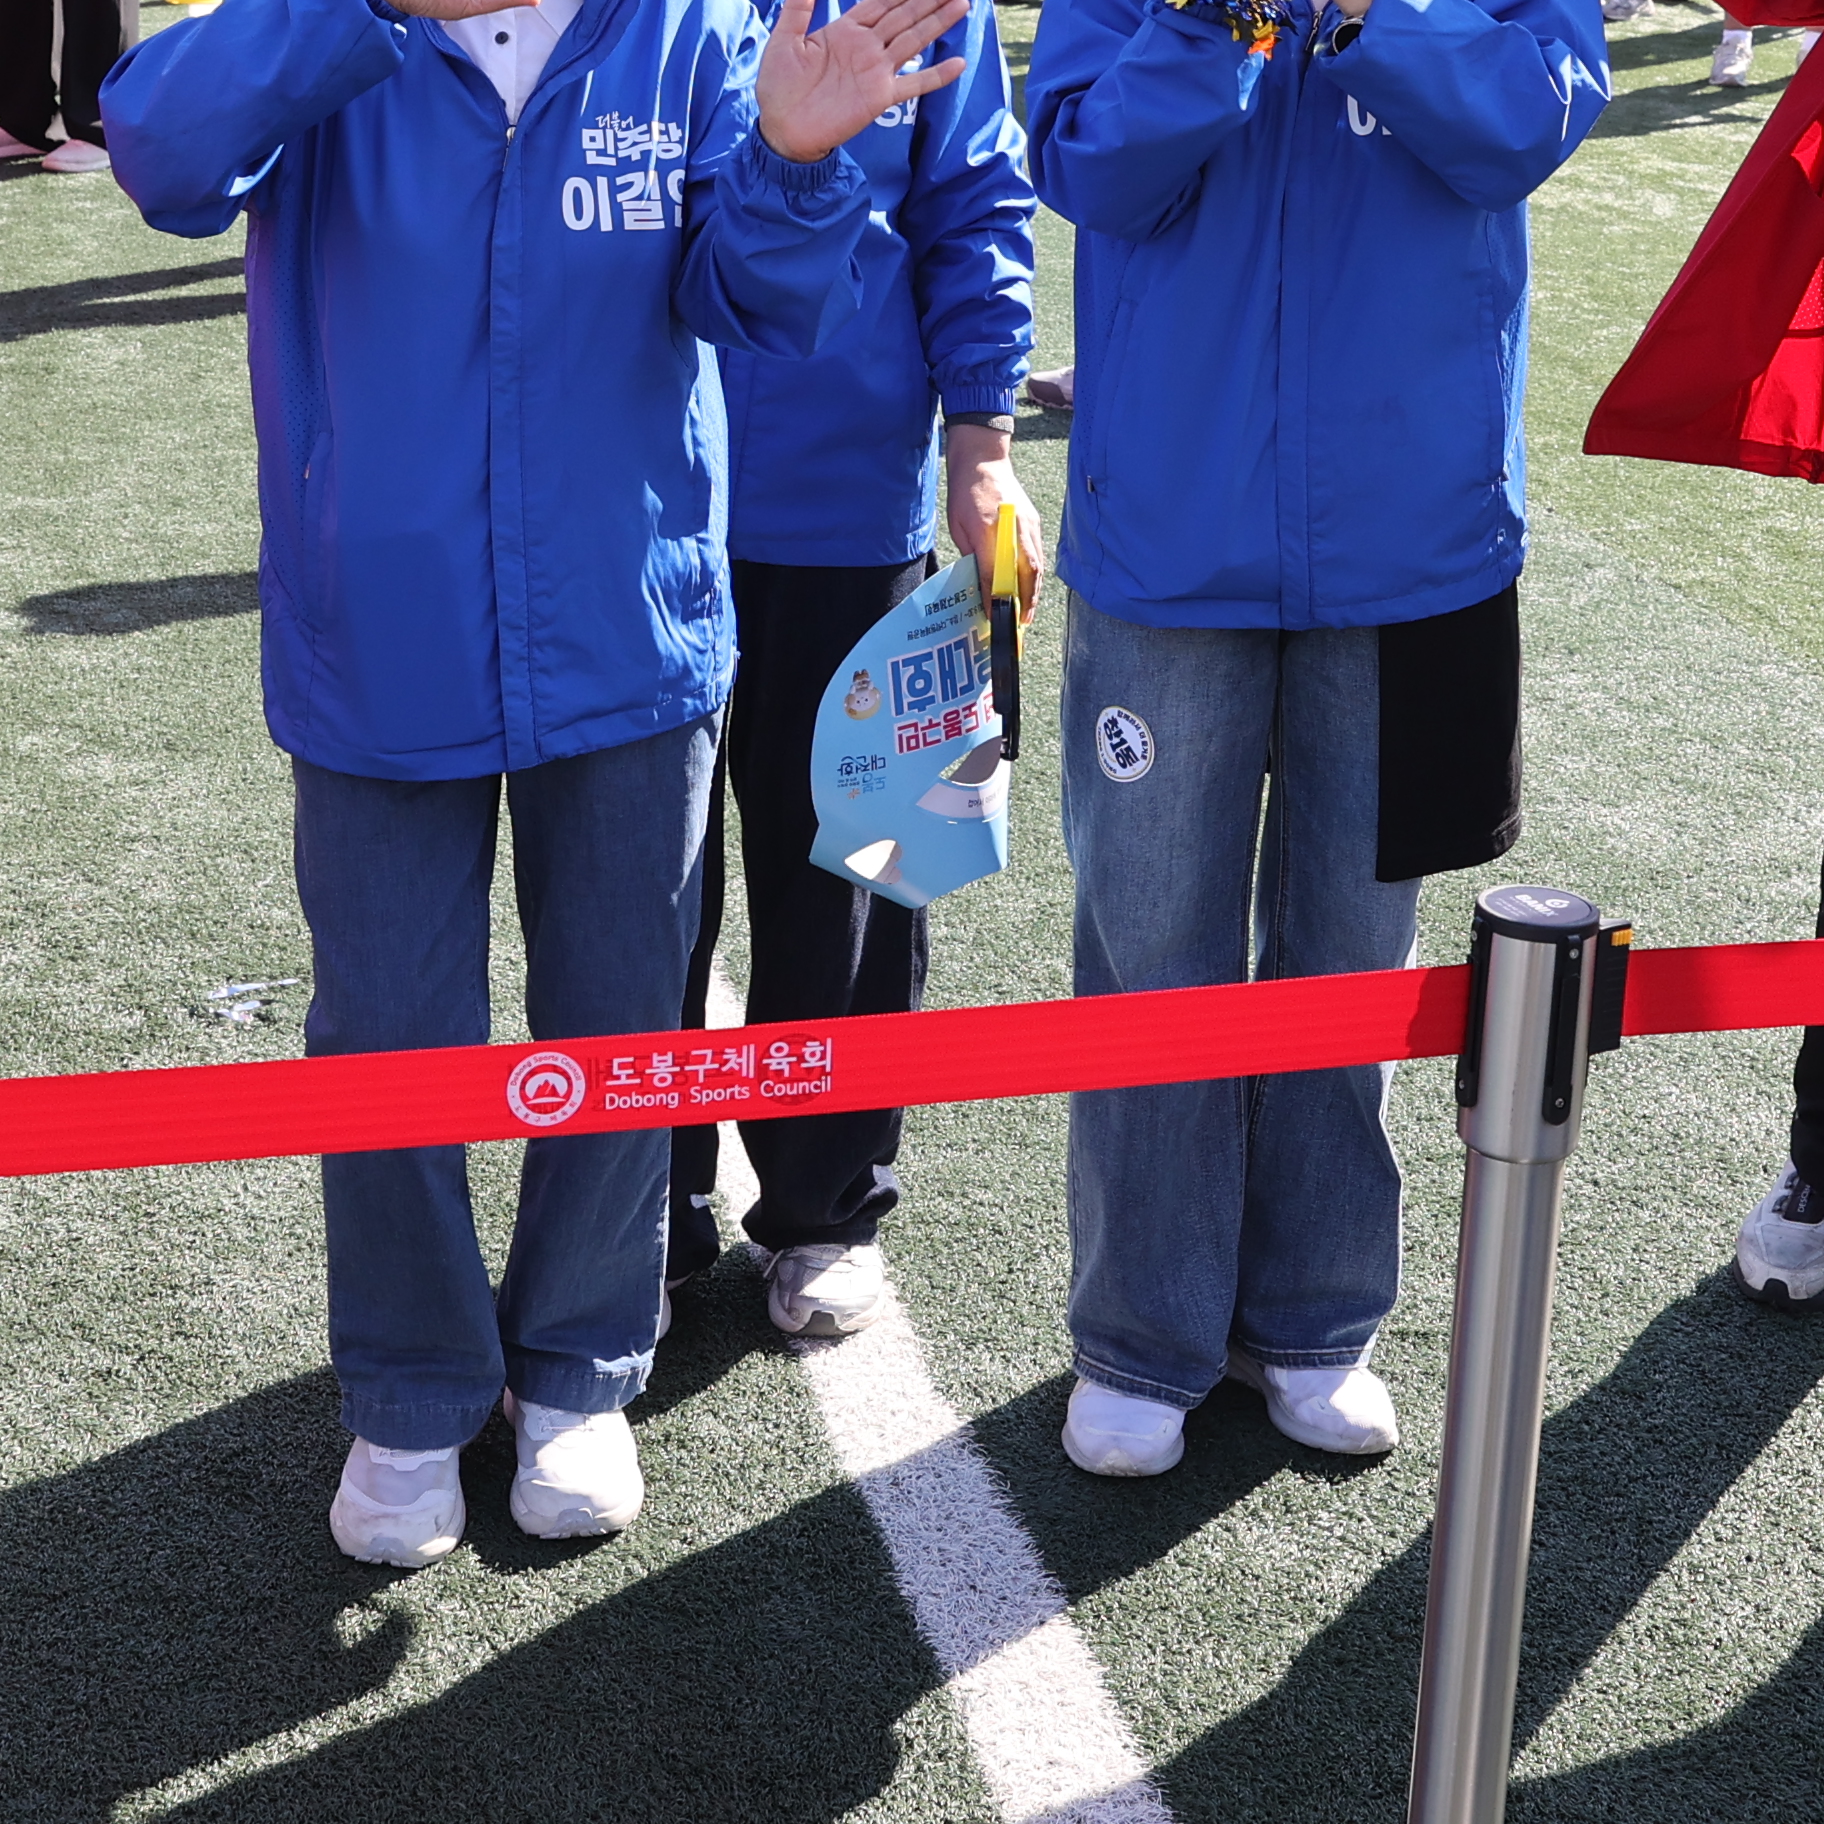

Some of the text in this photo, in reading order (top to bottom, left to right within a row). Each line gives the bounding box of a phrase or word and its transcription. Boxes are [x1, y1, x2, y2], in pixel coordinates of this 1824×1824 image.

[582, 124, 684, 166] 민주당
[595, 113, 635, 131] 더불어
[896, 701, 980, 755] 도봉구민
[1103, 714, 1140, 770] 창1동
[605, 1037, 832, 1087] 도봉구체육회
[605, 1076, 832, 1111] Dobong Sports Council
